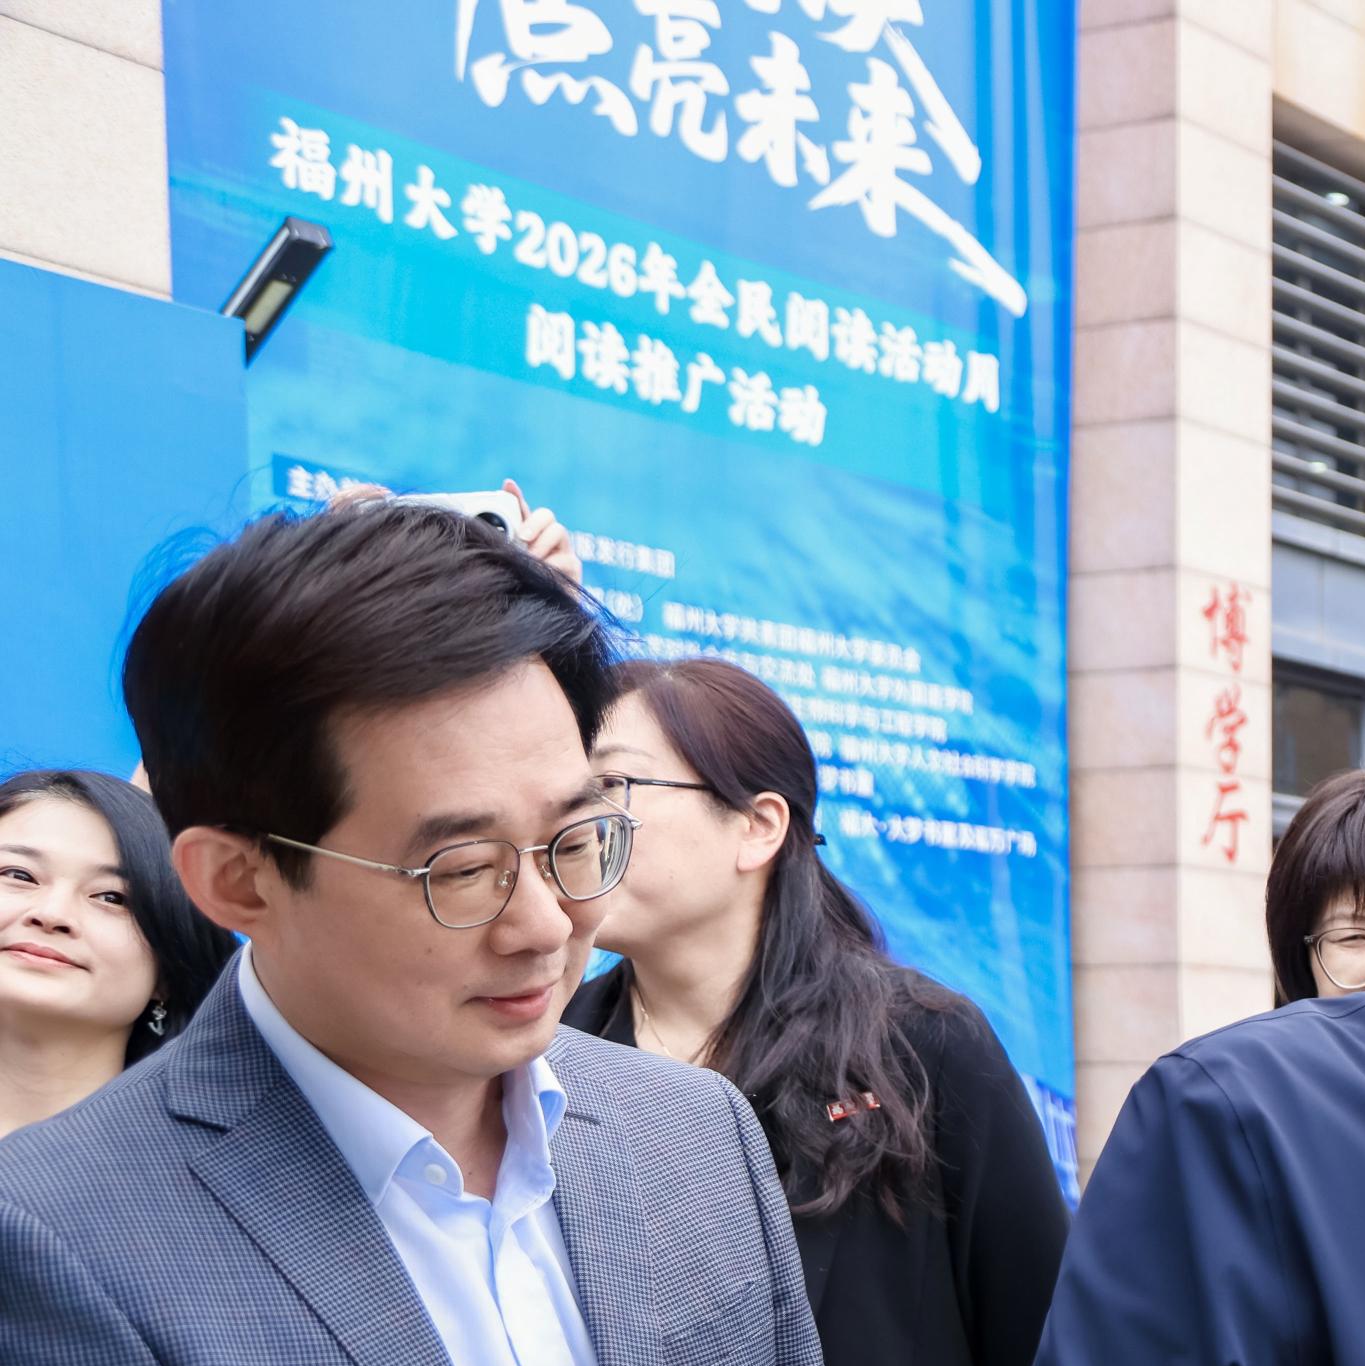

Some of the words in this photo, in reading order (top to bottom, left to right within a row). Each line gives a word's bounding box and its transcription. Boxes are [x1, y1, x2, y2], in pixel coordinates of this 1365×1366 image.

[269, 117, 1001, 412] 福州大学2026年全民阅读活动周
[526, 305, 828, 446] 阅读推广活动
